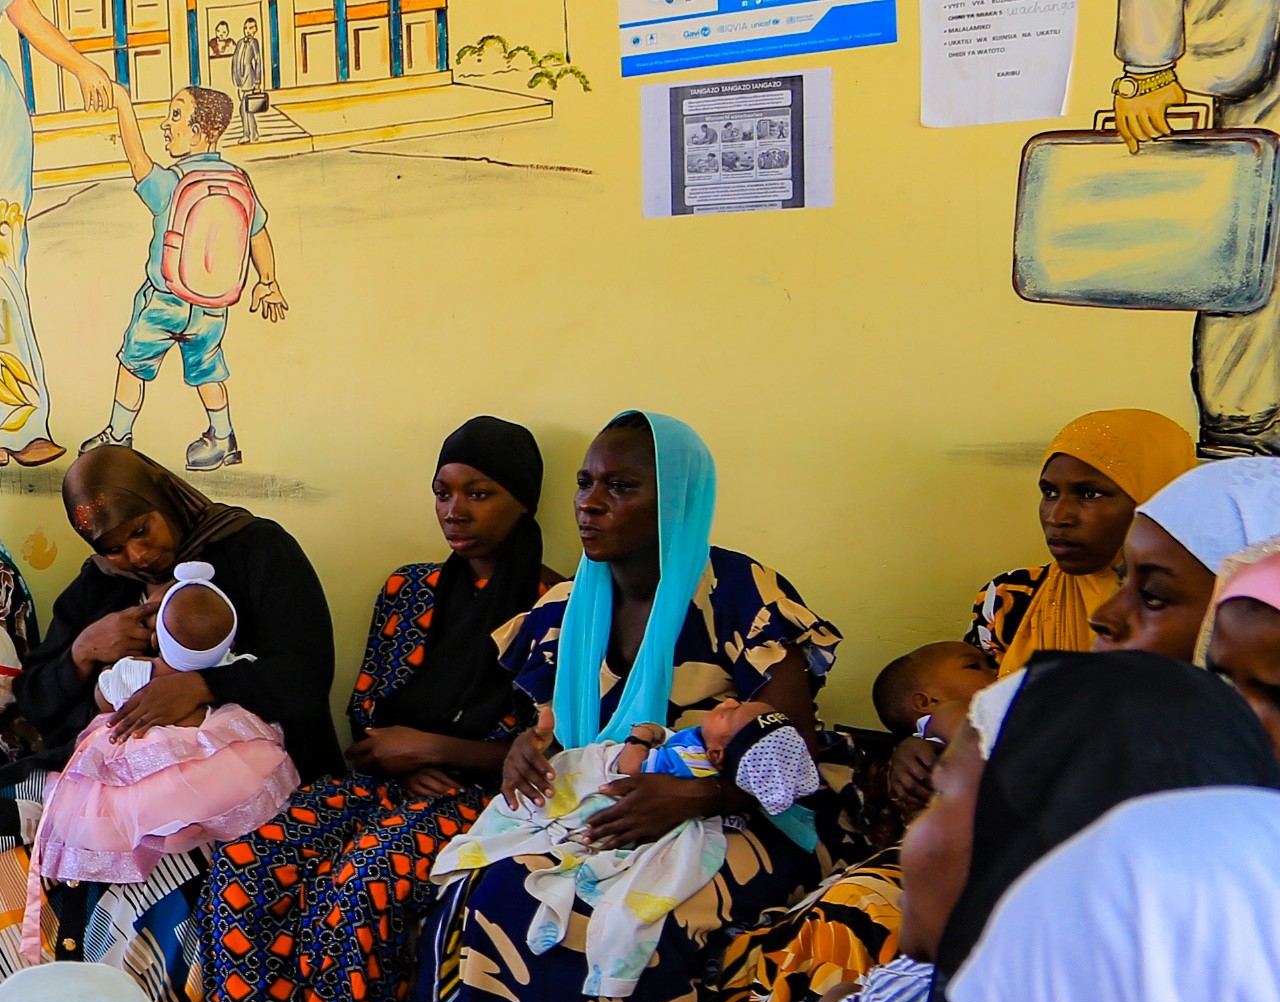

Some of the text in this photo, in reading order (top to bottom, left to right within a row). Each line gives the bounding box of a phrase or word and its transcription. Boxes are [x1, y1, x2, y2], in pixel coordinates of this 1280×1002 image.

[751, 19, 771, 29] unicef
[948, 24, 991, 34] MALALAMIKO
[683, 30, 700, 39] Gavi
[690, 86, 719, 95] TANGAZO
